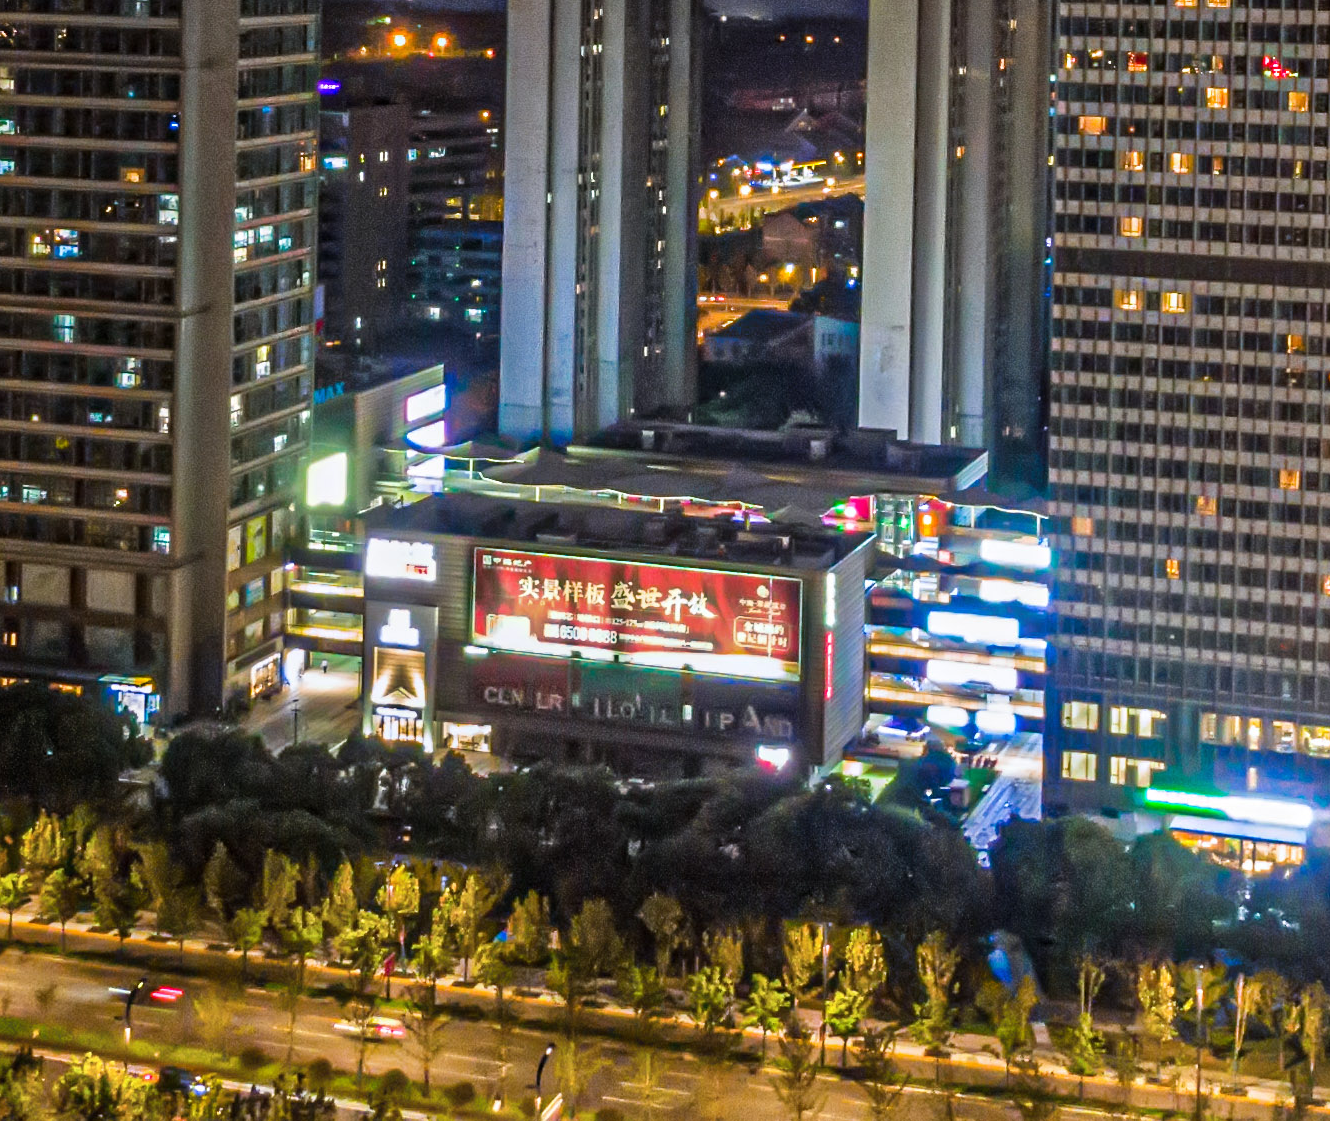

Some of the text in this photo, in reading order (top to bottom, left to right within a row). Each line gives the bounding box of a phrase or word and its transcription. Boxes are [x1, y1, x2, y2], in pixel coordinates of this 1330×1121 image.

[518, 576, 718, 621] 实景样板 盛世开放
